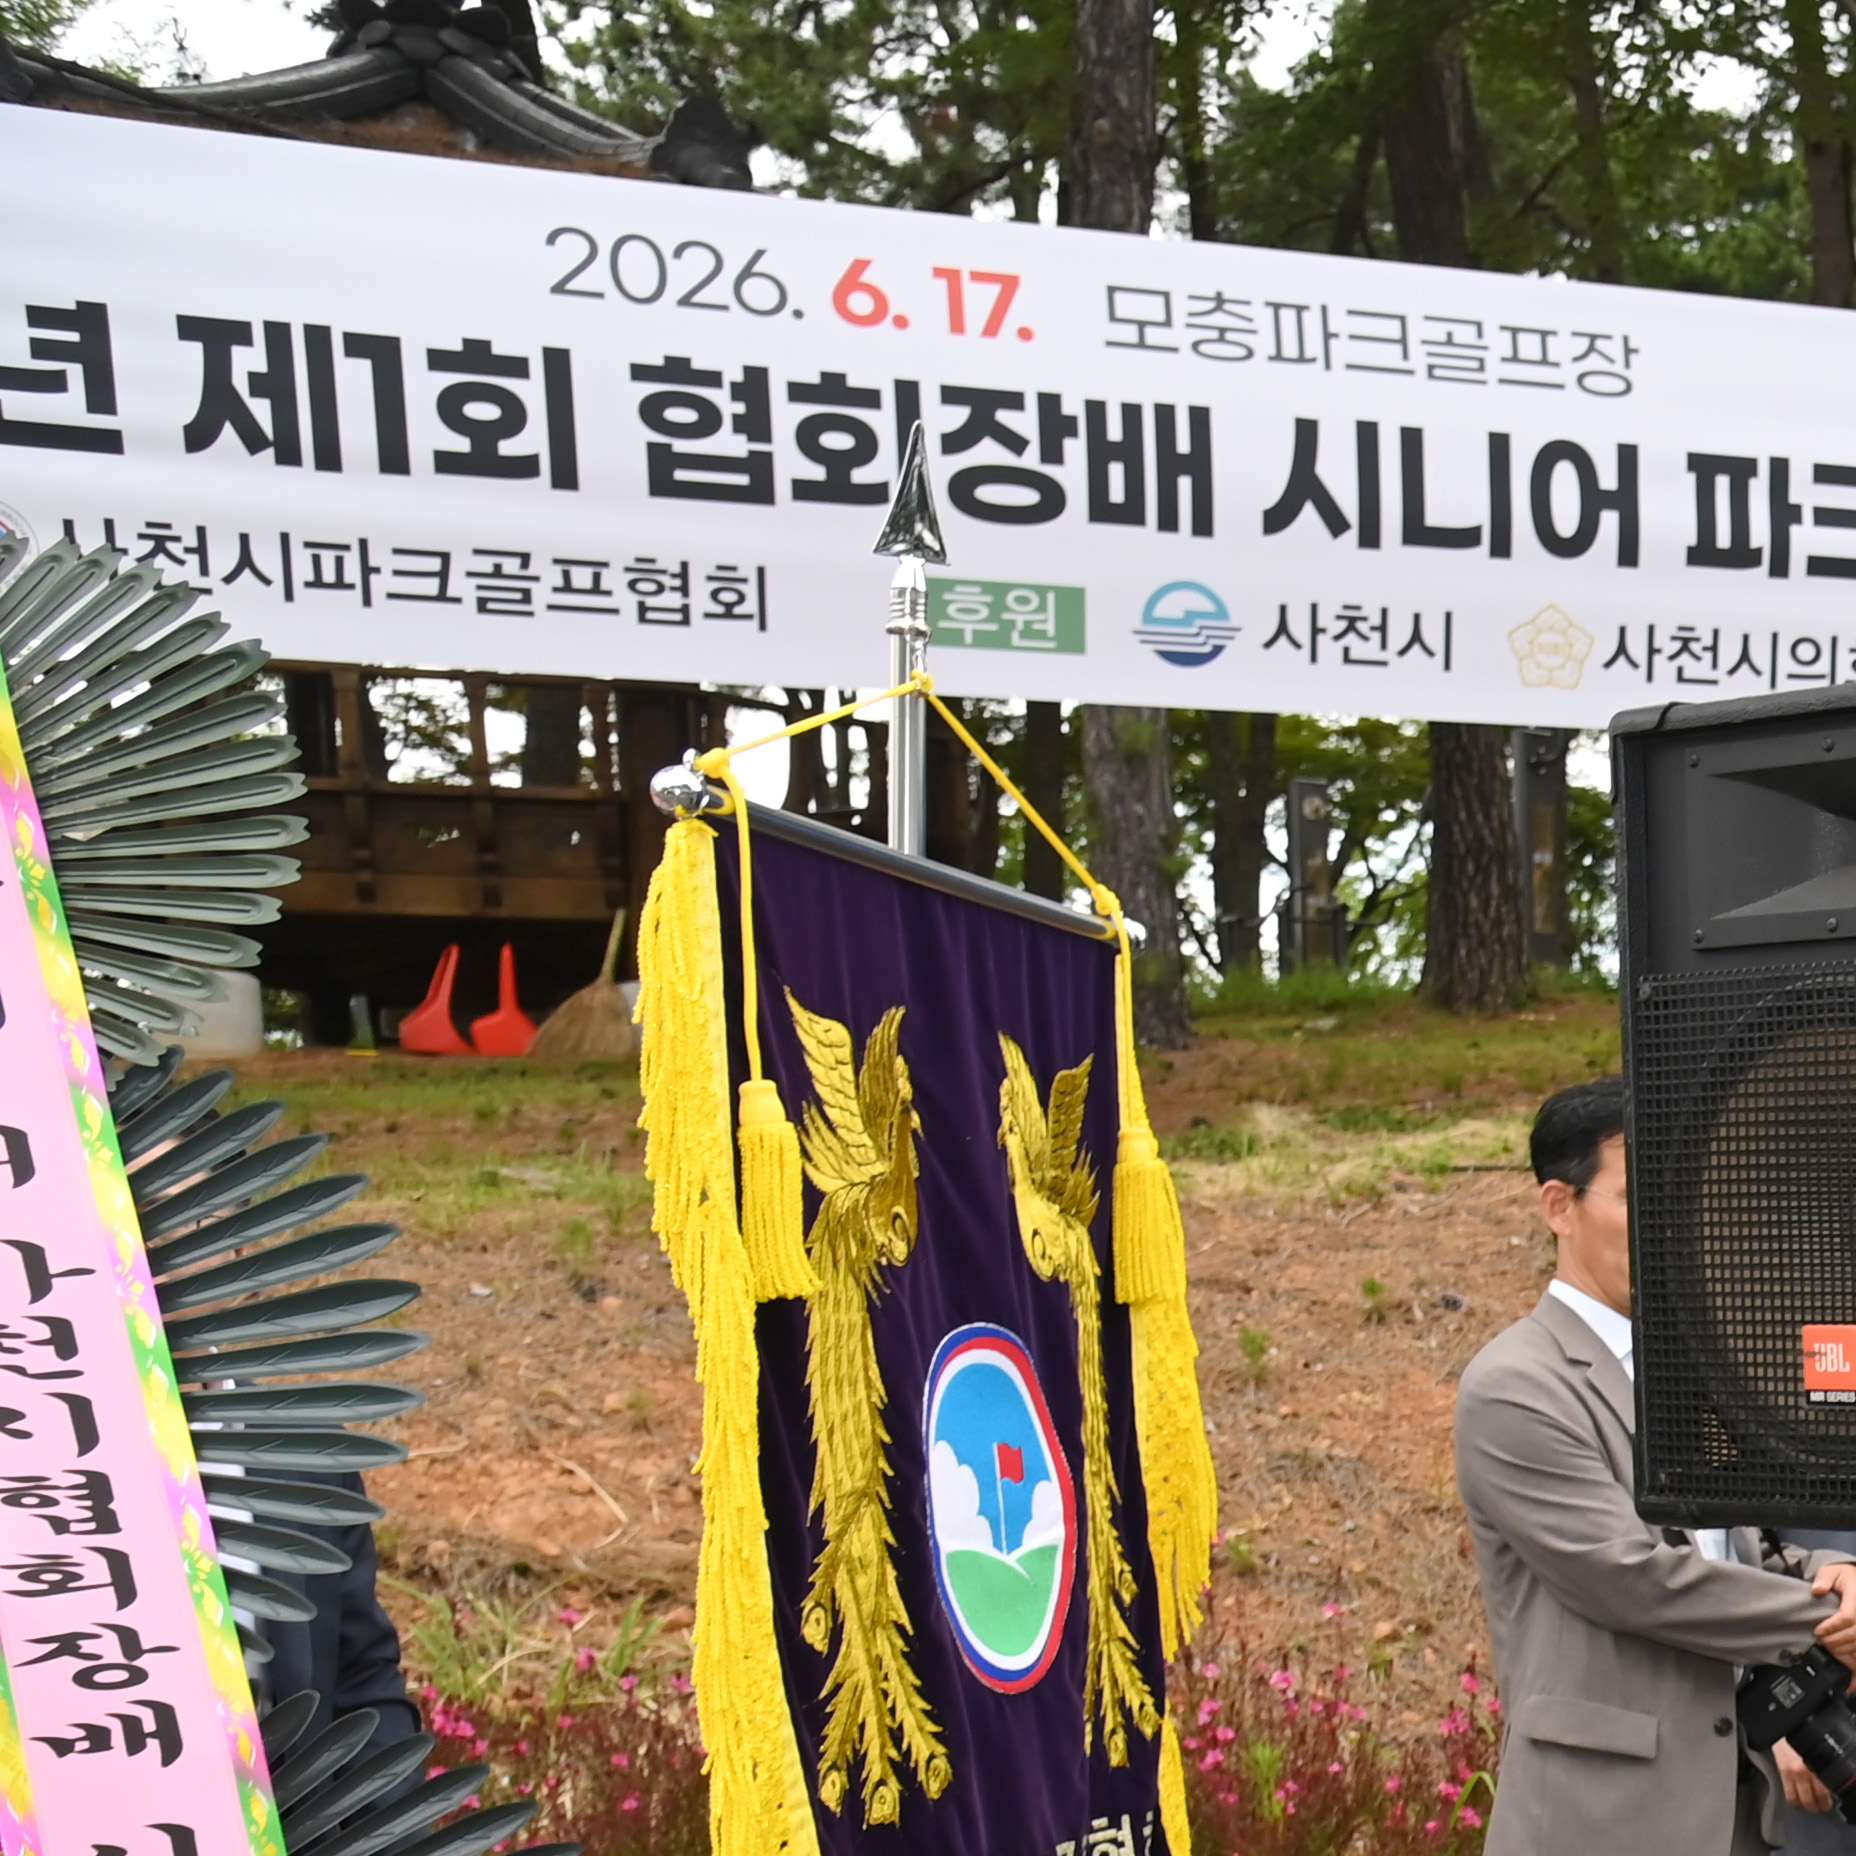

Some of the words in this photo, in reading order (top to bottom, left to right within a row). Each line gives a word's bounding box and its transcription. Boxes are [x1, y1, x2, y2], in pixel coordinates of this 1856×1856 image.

[544, 226, 804, 319] 2026.
[832, 258, 910, 329] 6.
[932, 265, 1035, 343] 17.
[1103, 282, 1640, 398] 모충파크골프장
[177, 313, 580, 491] 제1회
[629, 355, 1214, 538] 협회장배
[1262, 417, 1640, 567] 시니어
[936, 583, 1057, 651] 후원
[1261, 601, 1454, 673] 사천시
[1813, 1342, 1851, 1373] JBL
